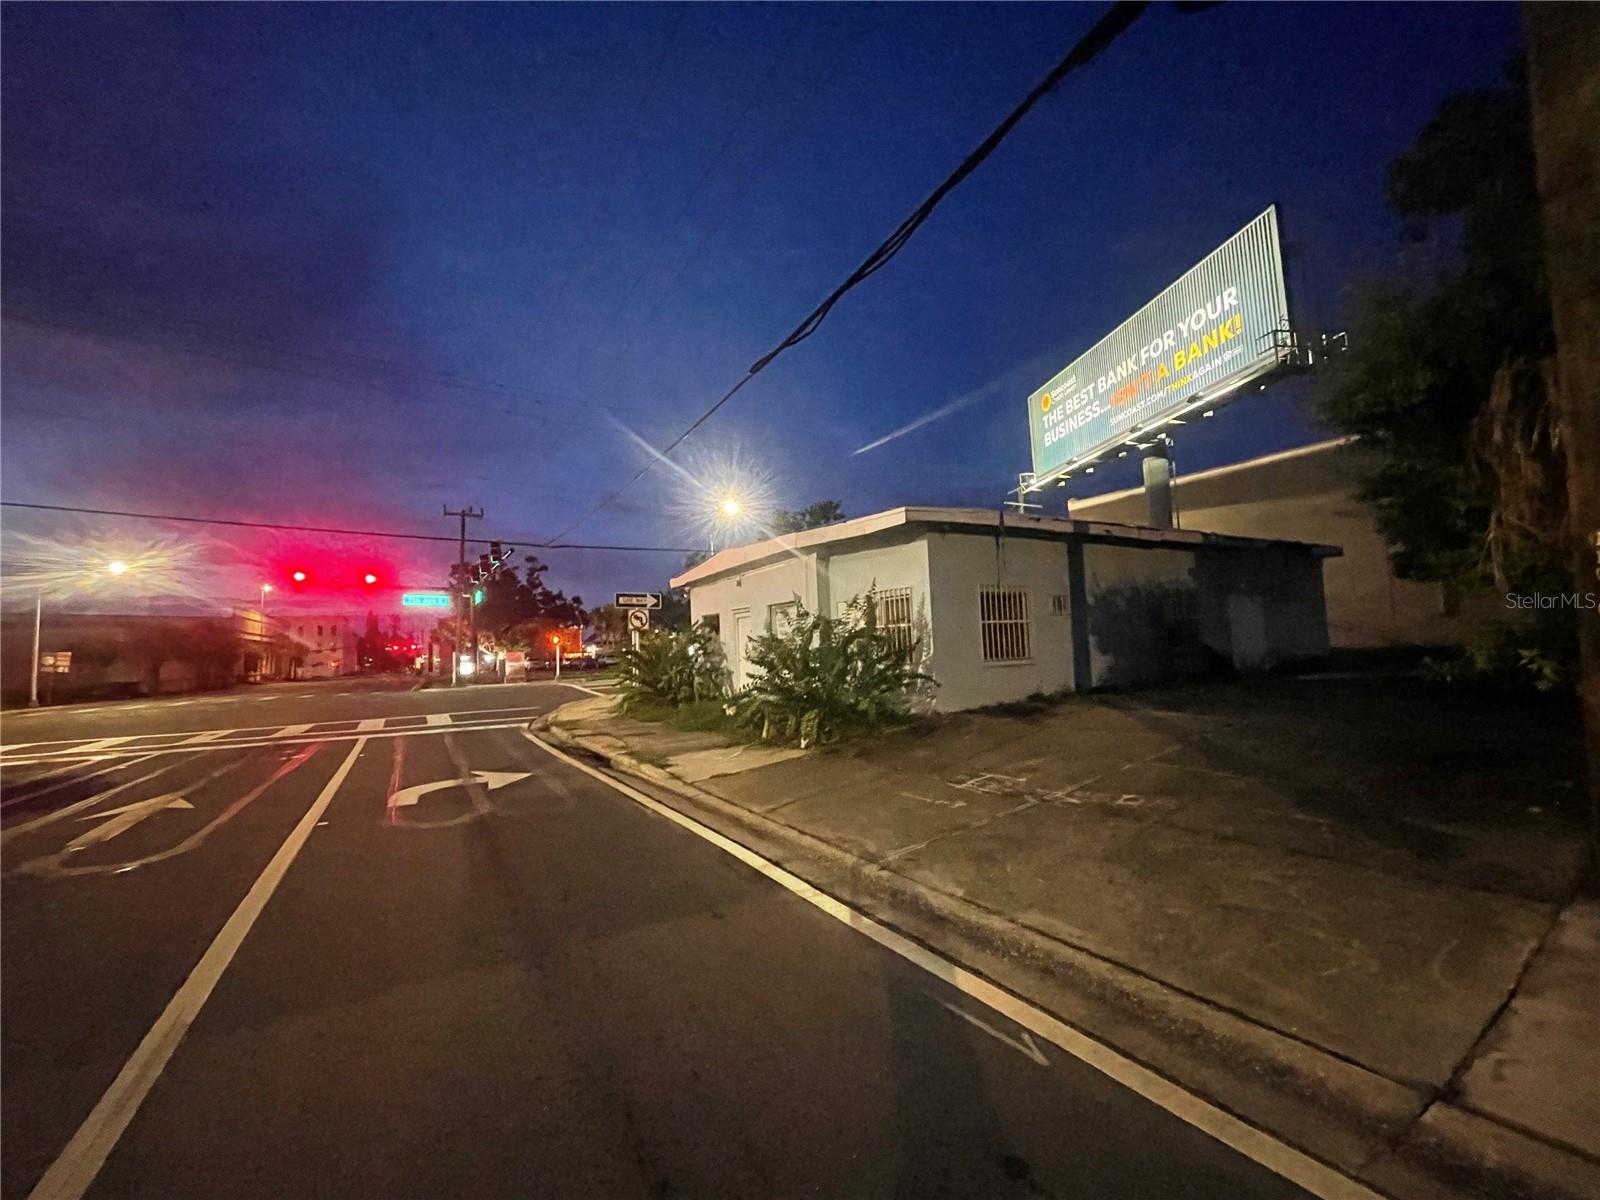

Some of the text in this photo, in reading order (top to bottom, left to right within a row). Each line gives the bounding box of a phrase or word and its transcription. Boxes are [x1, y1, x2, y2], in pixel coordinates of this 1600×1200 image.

[1042, 286, 1239, 429] THE BEST BANK FOR YOUR
[1044, 400, 1111, 447] BUSINESS...
[1154, 361, 1170, 384] A
[1173, 312, 1242, 372] BANK!
